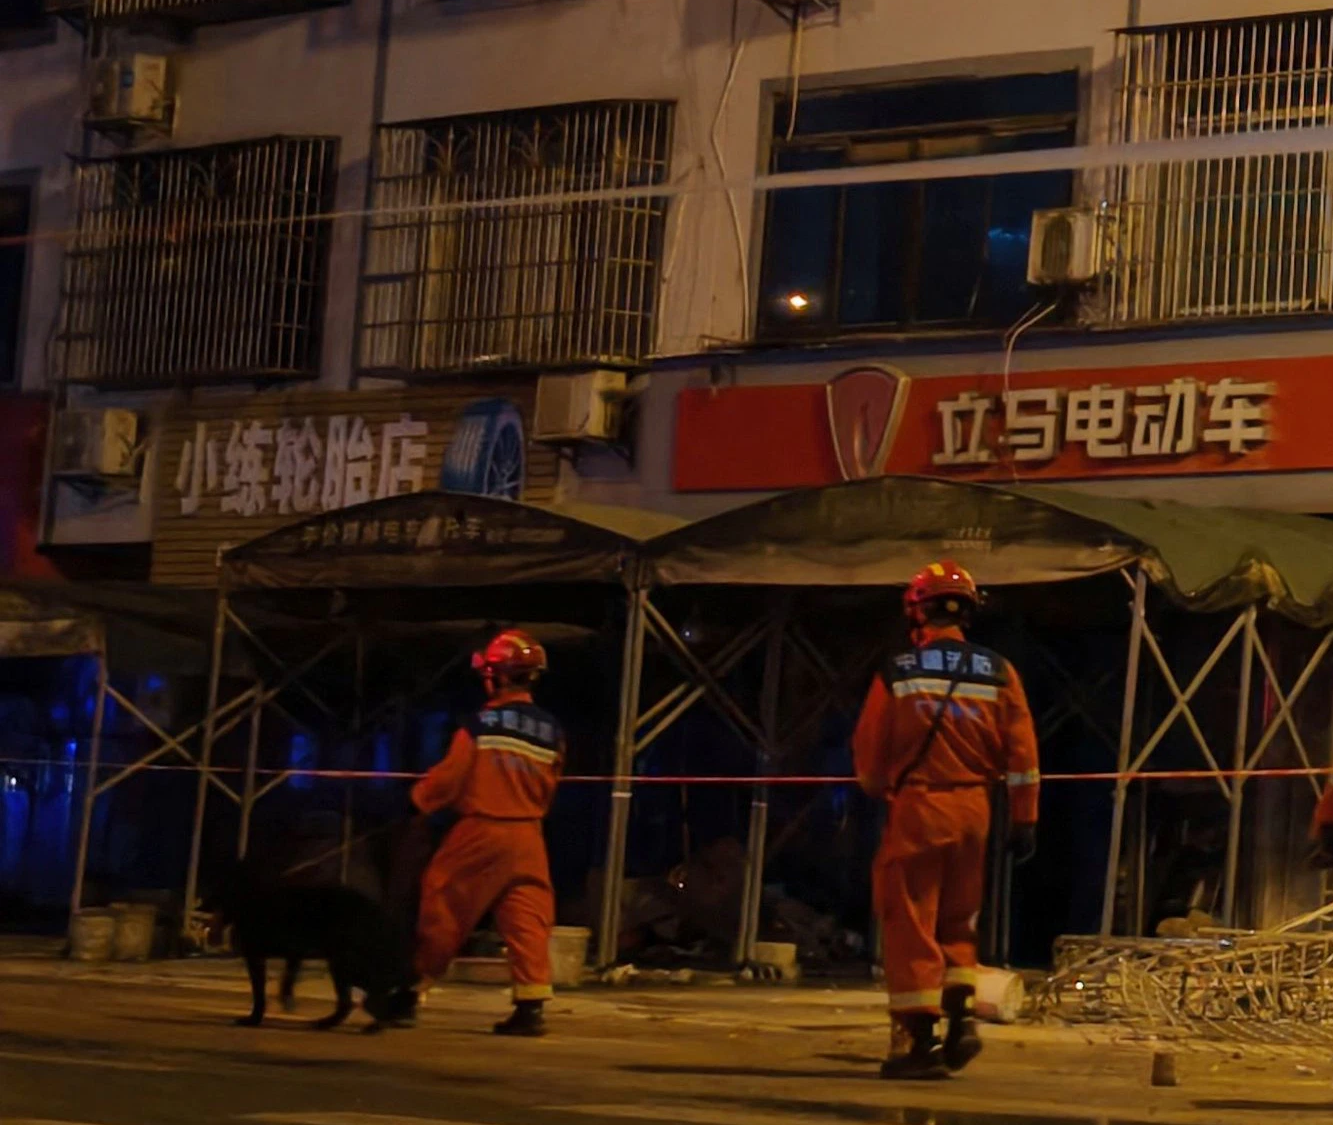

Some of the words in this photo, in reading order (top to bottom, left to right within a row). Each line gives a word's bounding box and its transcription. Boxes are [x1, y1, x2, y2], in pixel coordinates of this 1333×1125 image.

[176, 414, 428, 516] 小练轮胎店
[933, 378, 1276, 466] 立马电动车
